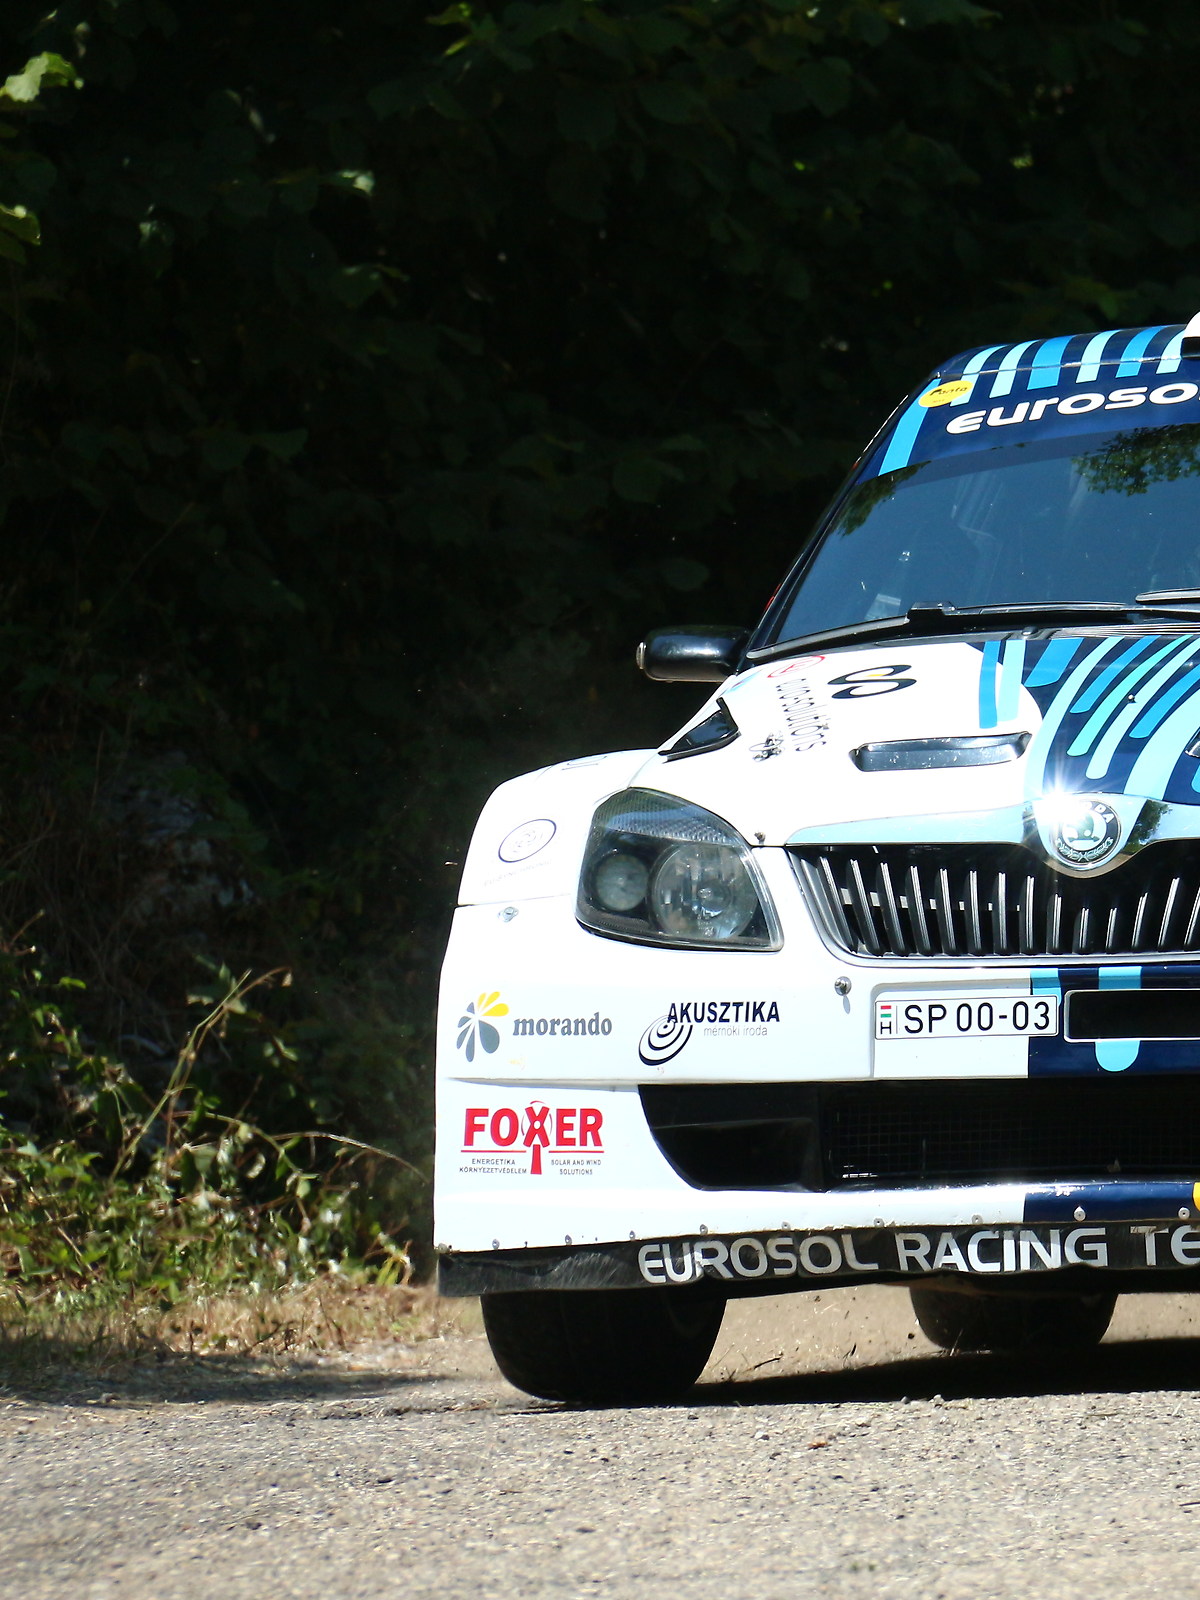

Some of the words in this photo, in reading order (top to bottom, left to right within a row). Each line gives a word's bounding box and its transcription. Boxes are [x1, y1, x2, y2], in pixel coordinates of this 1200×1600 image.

[512, 1011, 613, 1037] morando
[667, 1000, 781, 1024] AKUSZTIKA
[903, 1004, 948, 1034] SP
[955, 1001, 1052, 1030] 00-03
[743, 1025, 769, 1037] iroda
[463, 1105, 603, 1149] FOXER
[559, 1168, 593, 1176] SOLUTIONS
[637, 1234, 879, 1284] EUROSOL
[894, 1226, 1109, 1273] RACING
